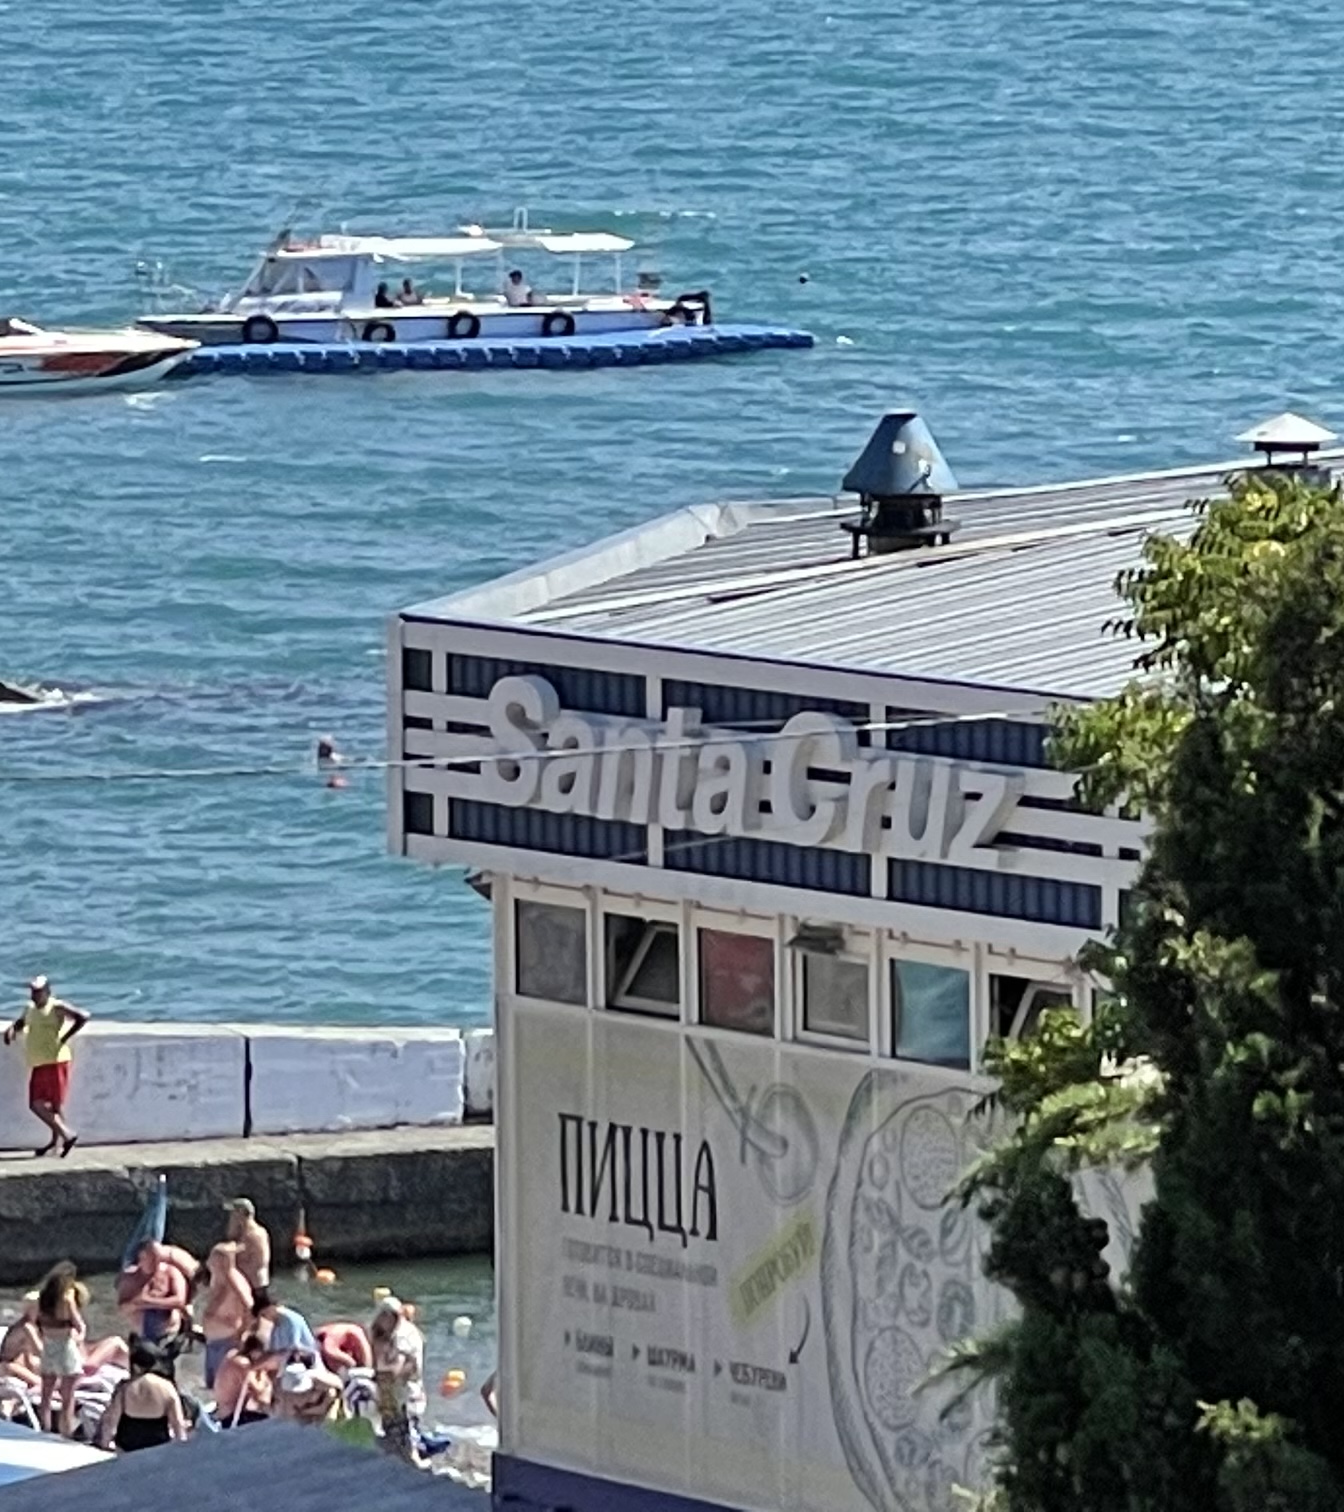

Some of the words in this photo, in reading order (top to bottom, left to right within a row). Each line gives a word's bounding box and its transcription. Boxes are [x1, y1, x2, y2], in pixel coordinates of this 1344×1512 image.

[479, 674, 760, 835] Santa
[764, 711, 1025, 868] Cruz
[558, 1112, 717, 1248] ПИЦЦА
